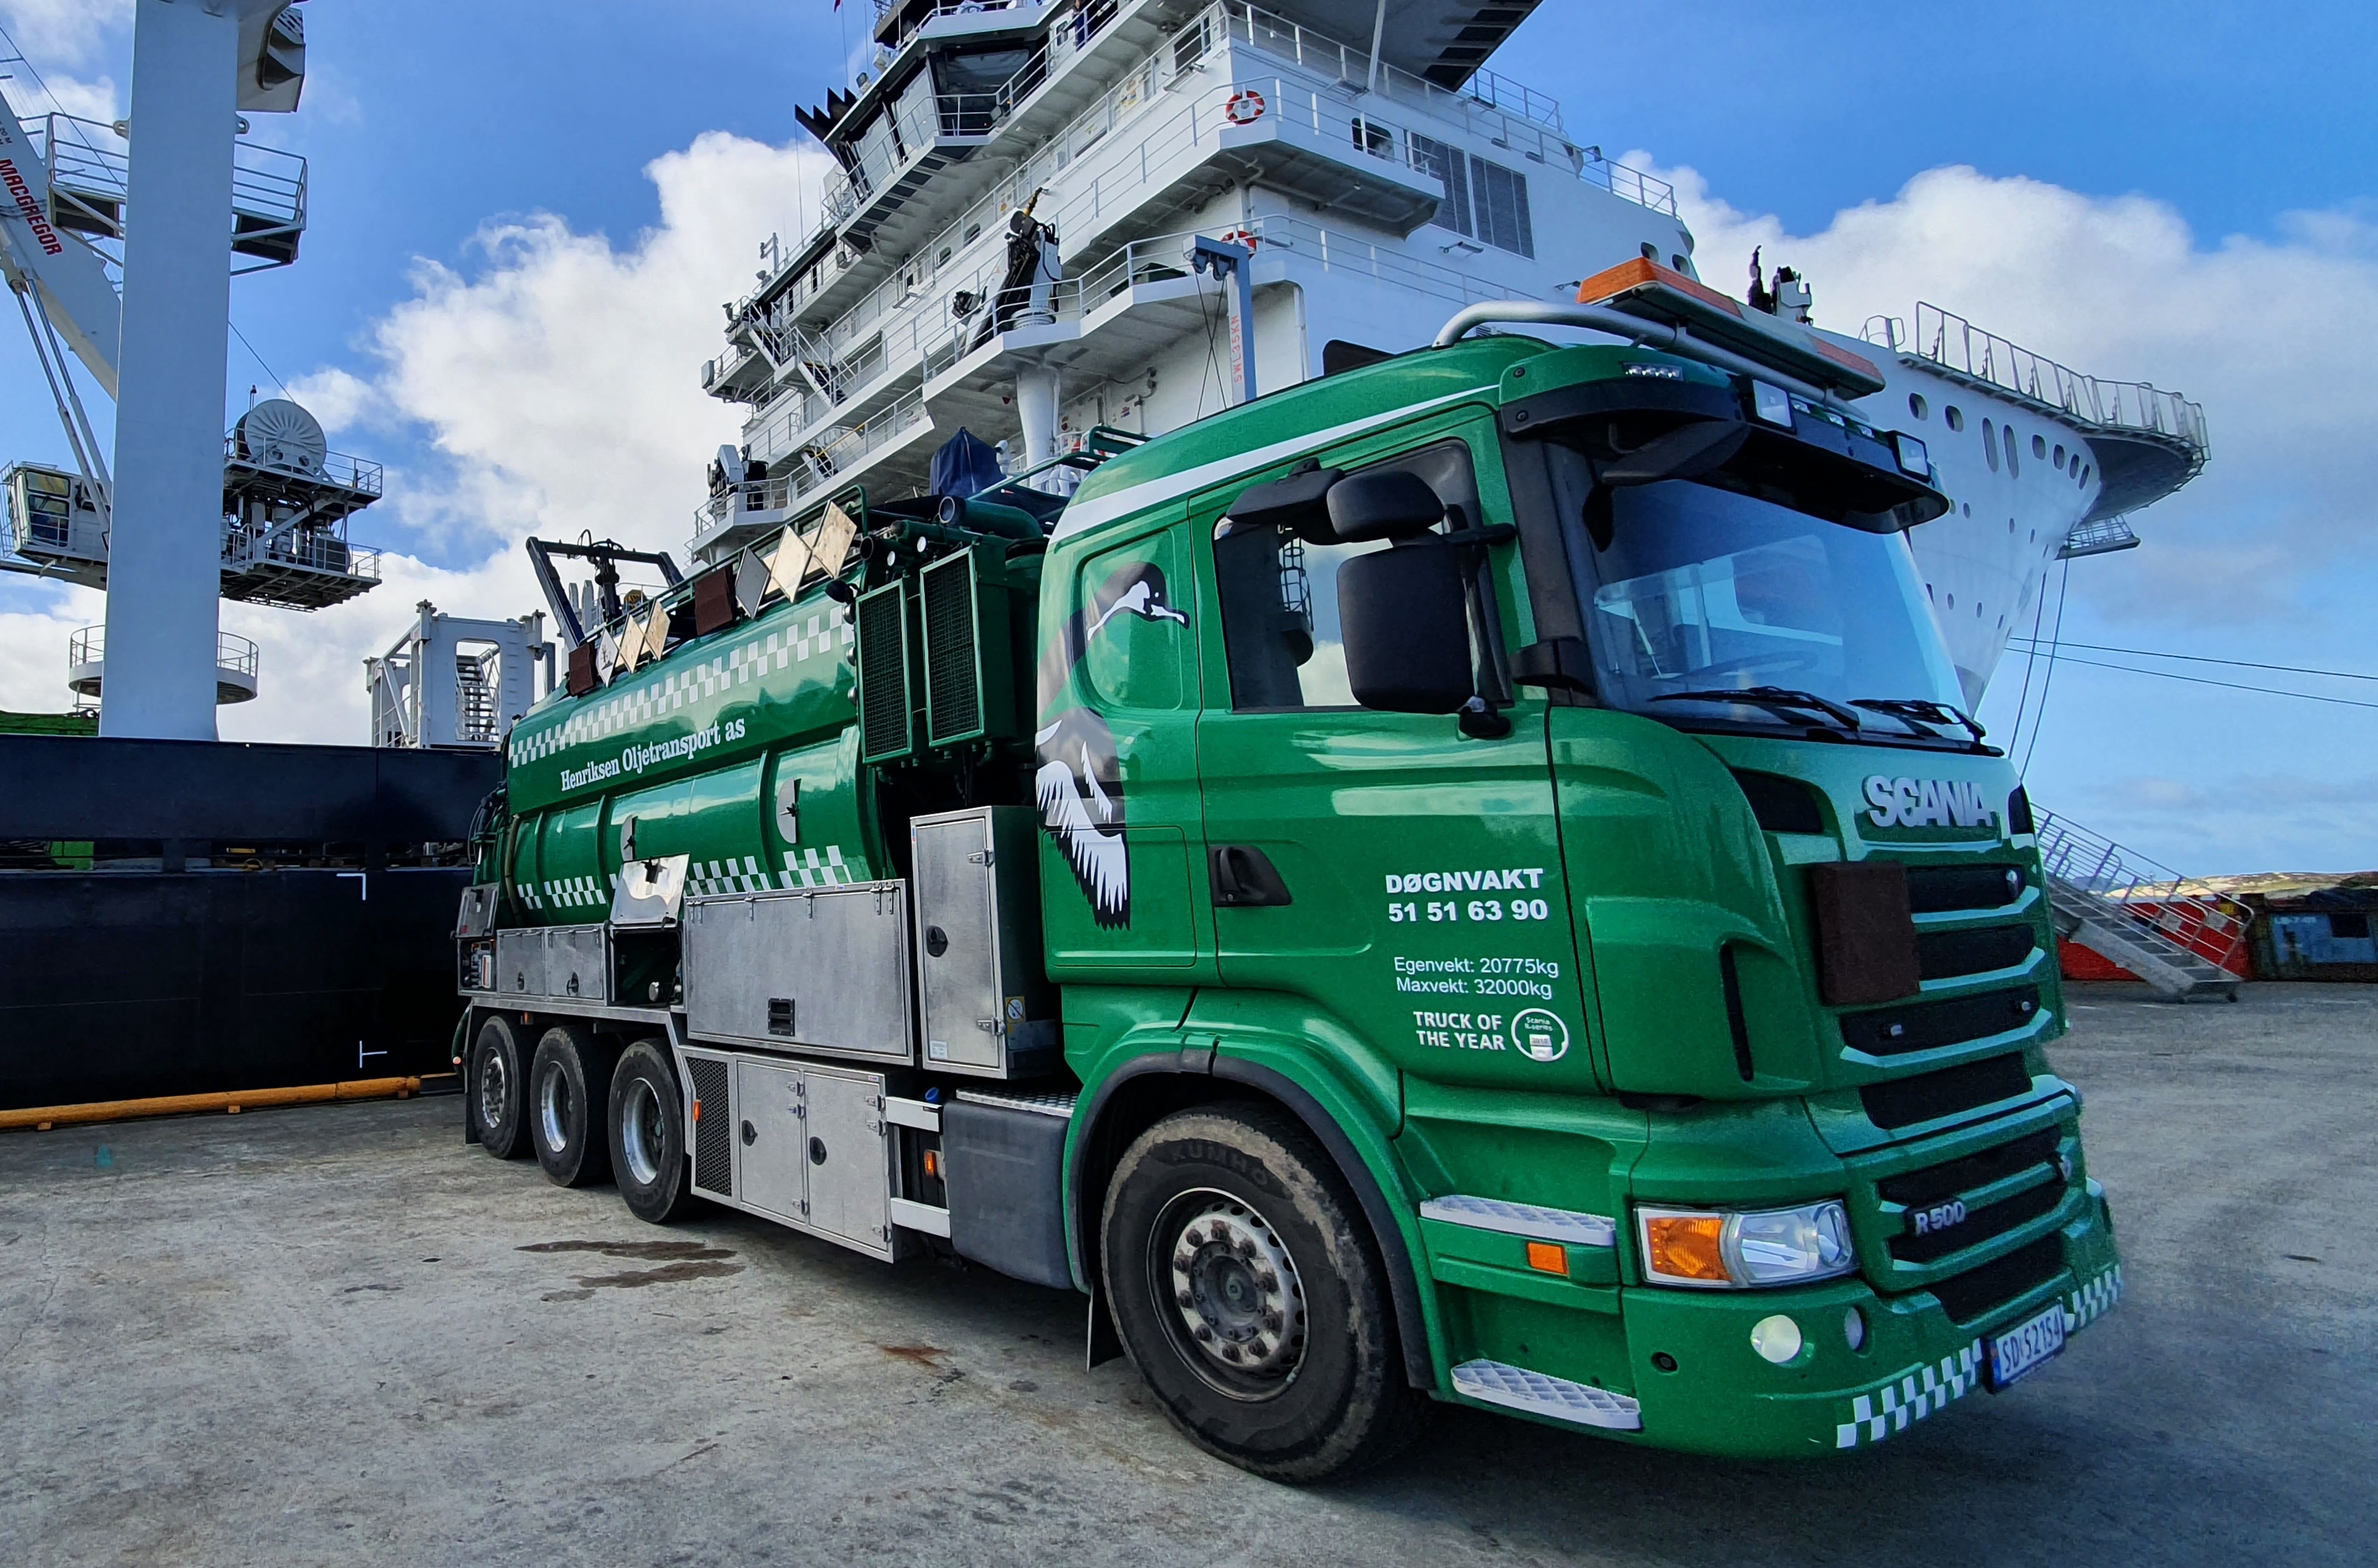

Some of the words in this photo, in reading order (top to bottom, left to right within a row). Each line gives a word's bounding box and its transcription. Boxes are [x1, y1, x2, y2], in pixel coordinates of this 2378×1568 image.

[0, 158, 64, 255] MACGREGOR
[561, 758, 621, 791] Henriksen
[622, 720, 721, 775] Oljetransport
[725, 718, 746, 742] as
[1863, 775, 1993, 828] SCANIA
[1385, 868, 1543, 894] DØGNVAKT
[1389, 903, 1417, 921] 51
[1427, 901, 1457, 921] 51
[1468, 900, 1502, 920] 63
[1510, 899, 1548, 920] 90
[1394, 956, 1475, 975] Egenvekt:
[1480, 958, 1559, 978] 20775kg
[1396, 977, 1468, 994] Maxvekt:
[1473, 979, 1552, 1000] 32000kg
[1413, 1011, 1473, 1029] TRUCK
[1477, 1014, 1502, 1030] OF
[1416, 1030, 1450, 1047] THE
[1454, 1032, 1506, 1050] YEAR
